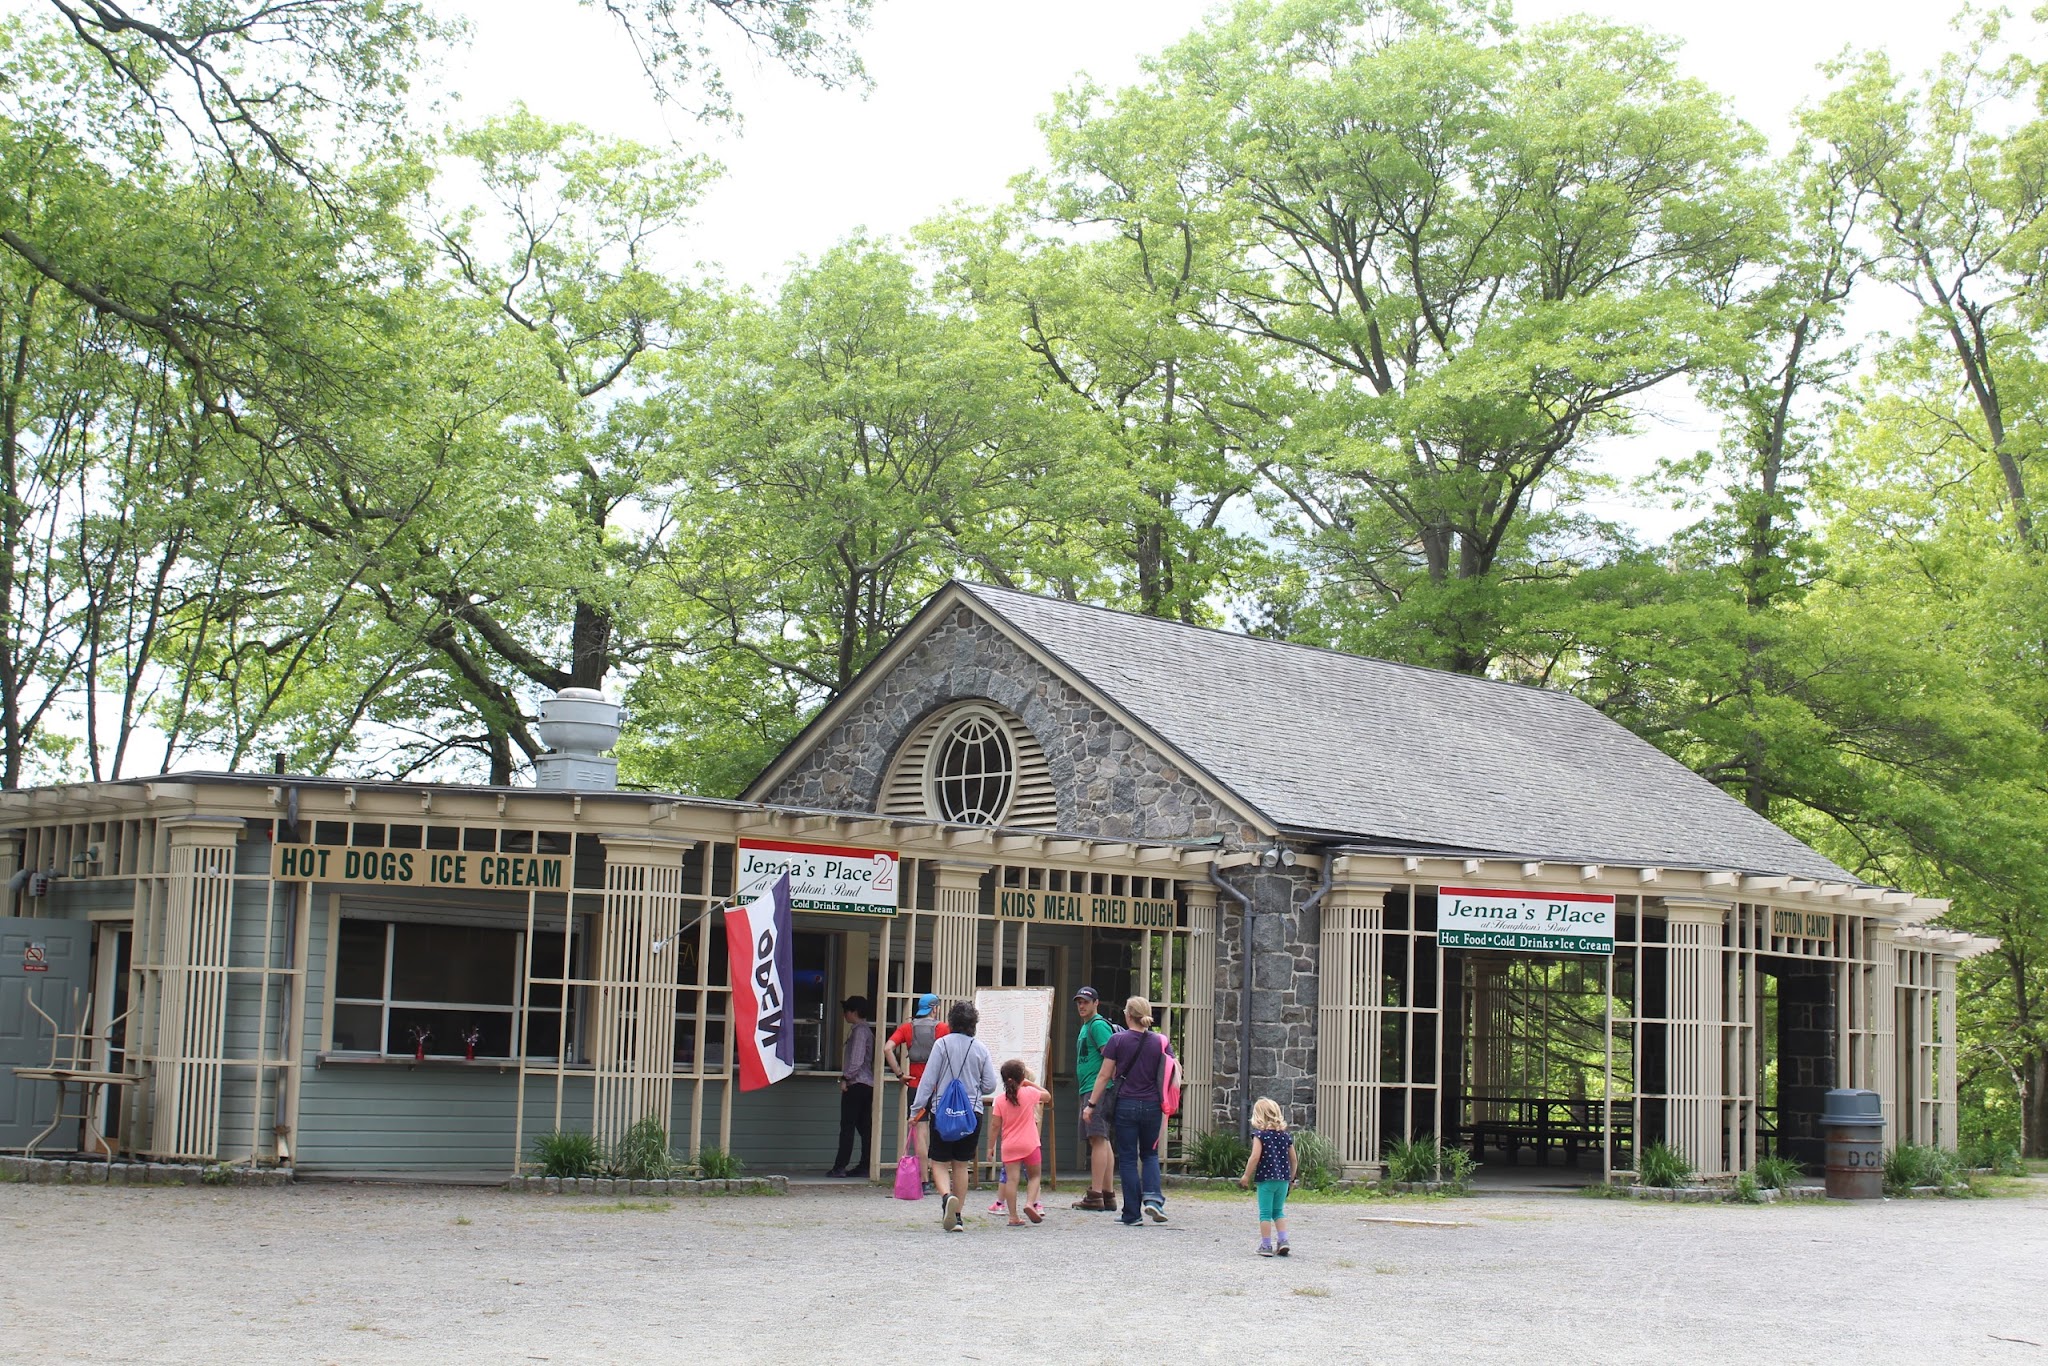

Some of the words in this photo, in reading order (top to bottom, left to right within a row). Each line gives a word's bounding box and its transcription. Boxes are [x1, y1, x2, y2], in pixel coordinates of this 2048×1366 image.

[281, 848, 330, 878] HOT
[344, 850, 414, 882] DOGS
[431, 854, 467, 884] ICE
[480, 856, 562, 888] CREAM
[743, 855, 815, 878] Jenna's
[824, 861, 871, 881] Place
[872, 853, 893, 891] 2
[755, 881, 767, 891] at
[831, 881, 862, 898] Pond
[792, 900, 810, 910] Cold
[813, 901, 840, 911] Drinks
[854, 903, 866, 913] Ice
[868, 904, 893, 914] Cream
[1001, 891, 1036, 918] KIDS
[1044, 894, 1084, 922] MEAL
[1092, 898, 1126, 924] FRIED
[1133, 901, 1173, 928] DOUGH
[1449, 899, 1536, 921] Jenna's
[1545, 904, 1606, 924] Place
[1491, 920, 1541, 932] Houghton's
[1545, 922, 1572, 933] Pond
[1774, 910, 1802, 935] COTTON
[1806, 914, 1830, 938] CANDY
[1441, 931, 1459, 945] Hot
[1463, 933, 1487, 946] Food
[1493, 934, 1515, 947] Cold
[1519, 936, 1554, 950] Drinks
[1560, 938, 1575, 950] Ice
[1578, 938, 1611, 952] Cream
